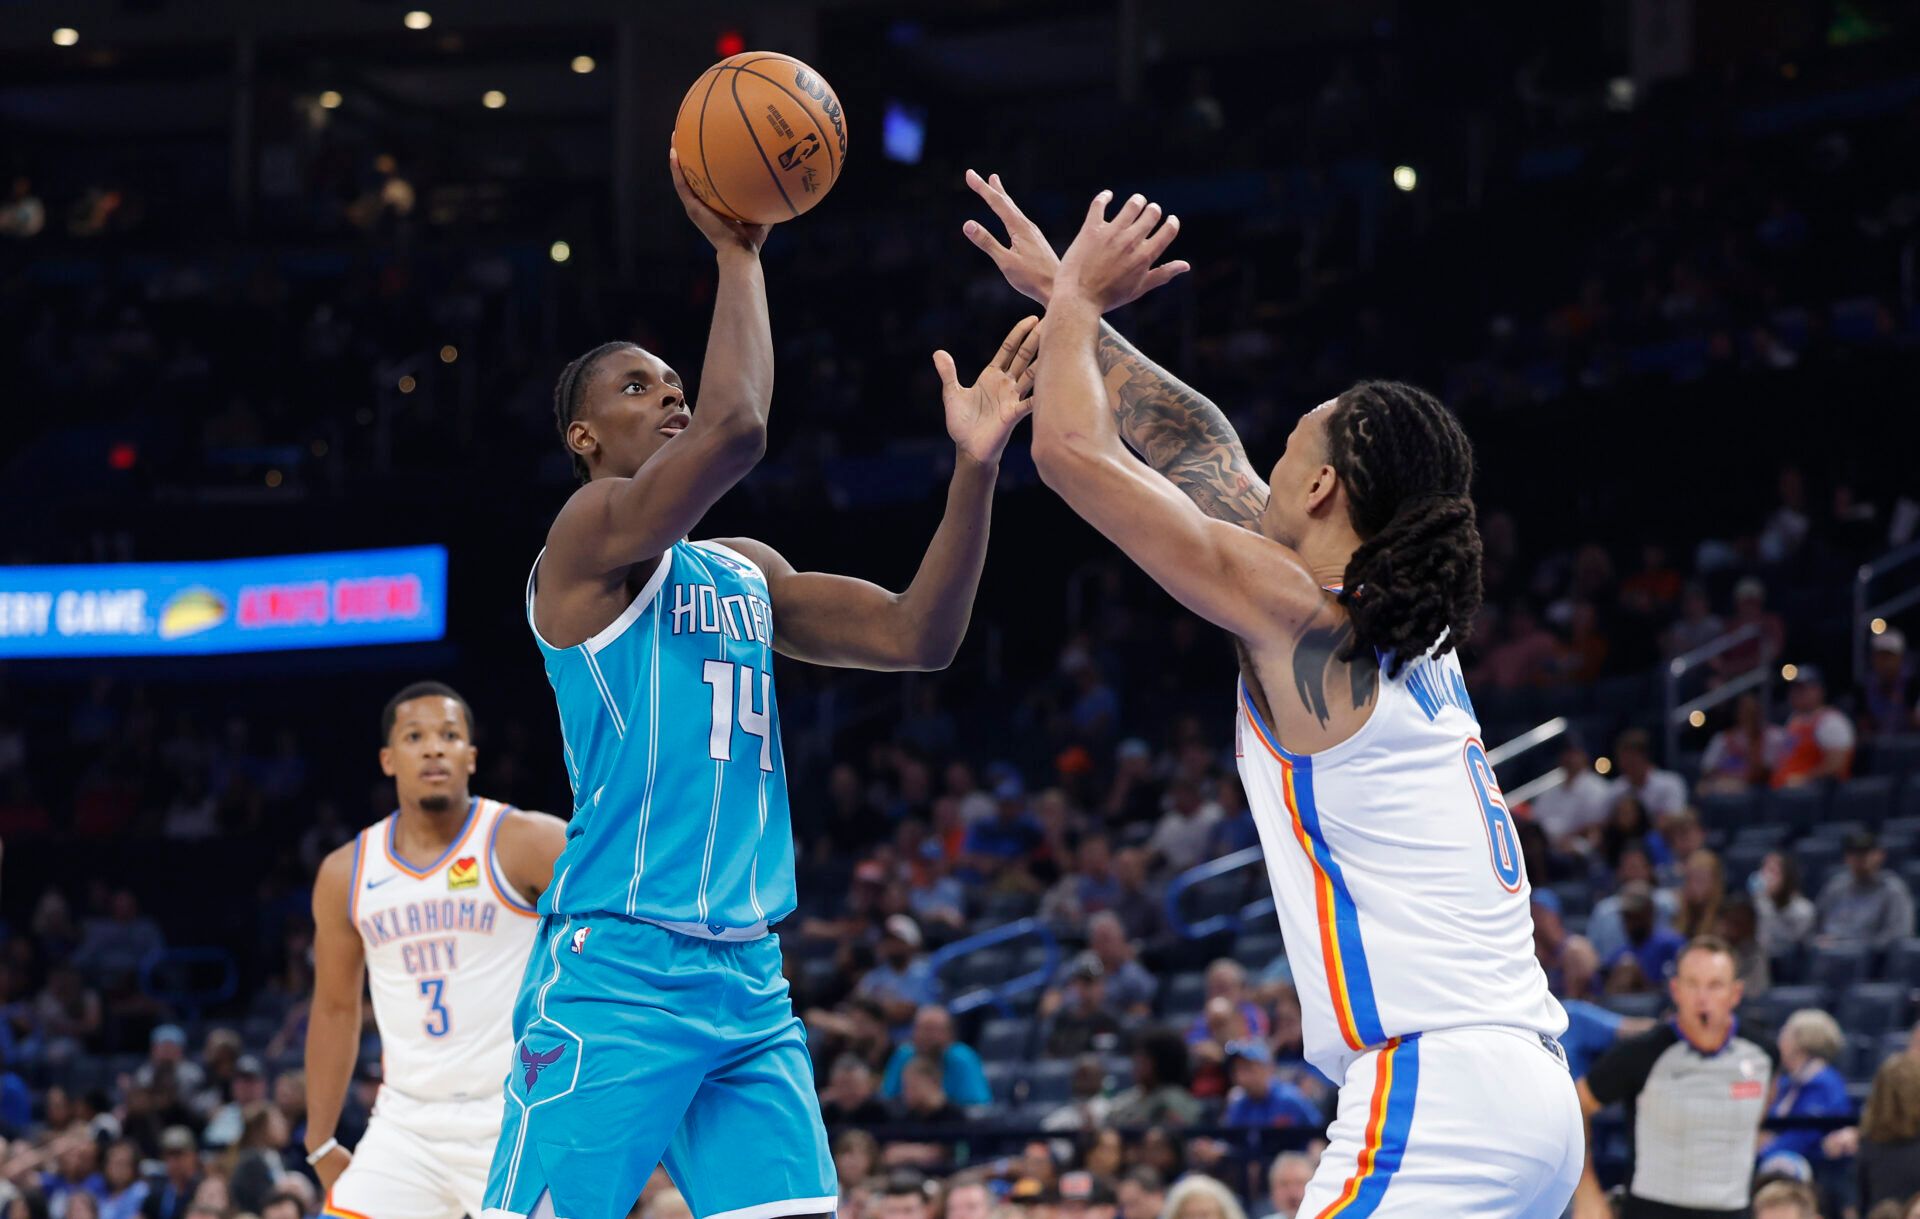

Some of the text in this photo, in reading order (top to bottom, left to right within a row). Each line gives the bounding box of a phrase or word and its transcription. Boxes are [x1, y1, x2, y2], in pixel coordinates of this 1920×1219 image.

[702, 658, 774, 772] 14
[1463, 737, 1523, 894] 6
[360, 899, 496, 949] OKLAHOMA
[401, 937, 457, 975] CITY
[417, 976, 452, 1040] 3
